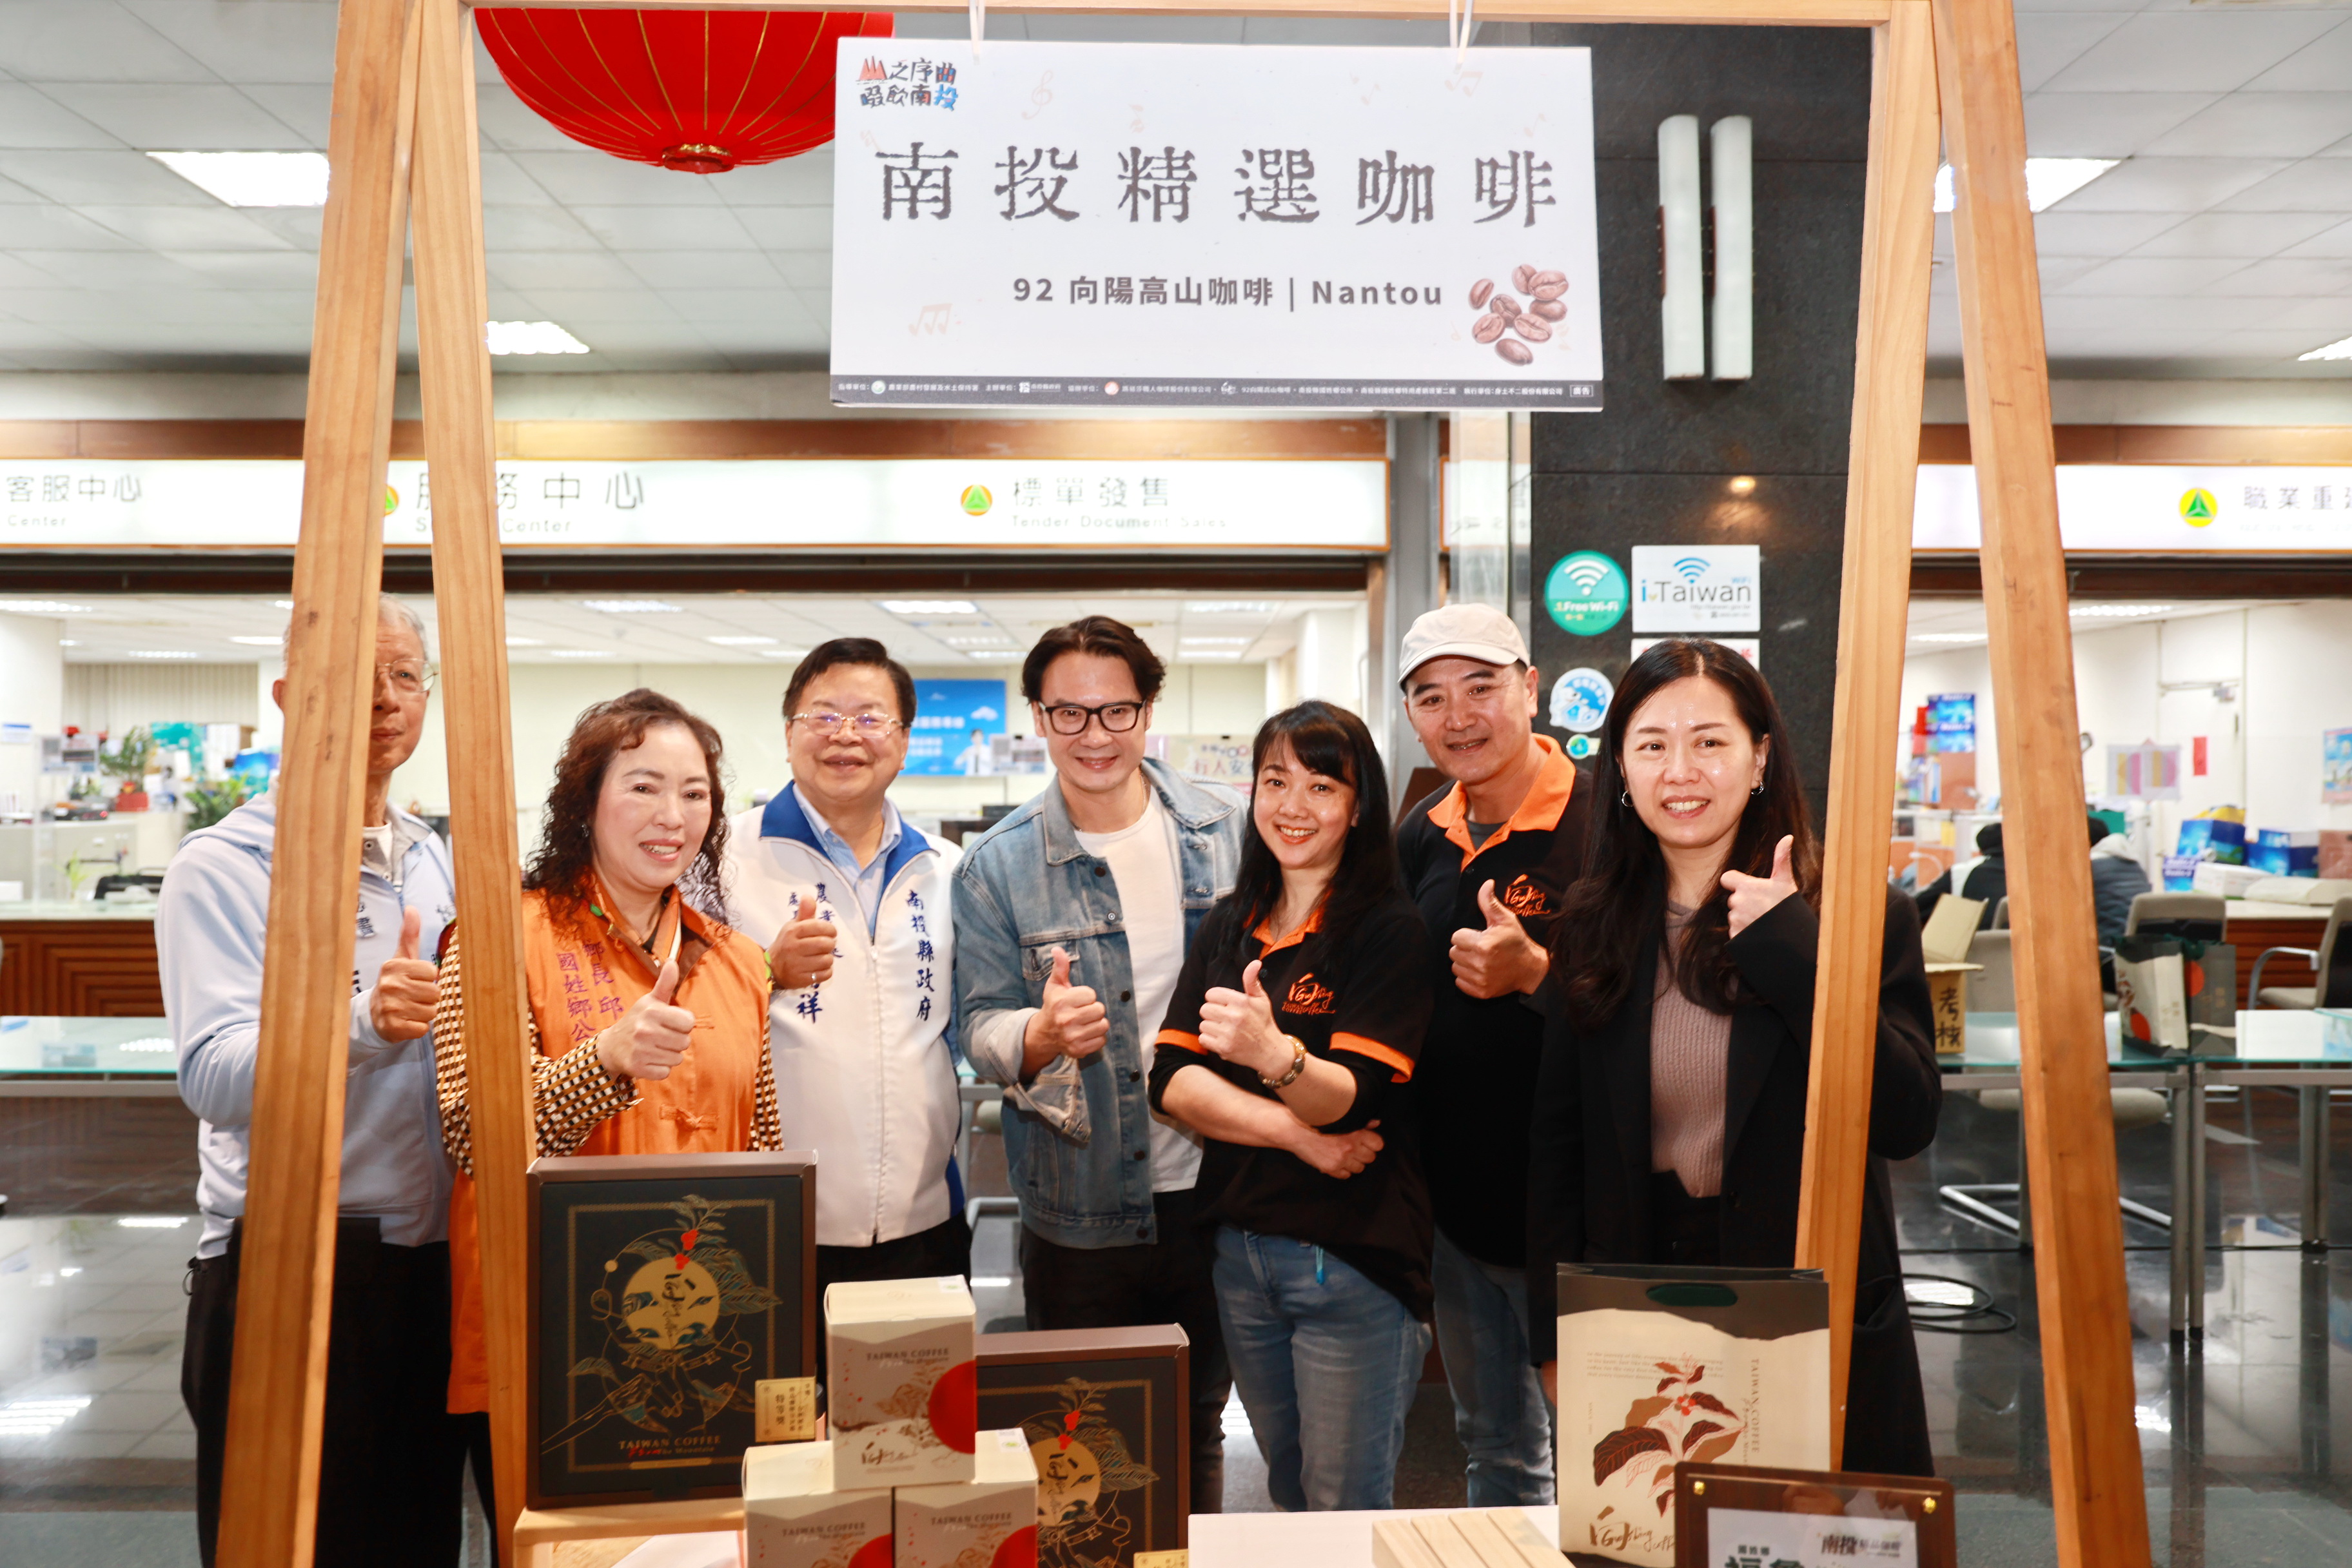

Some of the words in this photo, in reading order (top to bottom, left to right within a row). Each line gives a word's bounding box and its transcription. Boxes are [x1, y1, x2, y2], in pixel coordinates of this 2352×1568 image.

[875, 141, 1556, 228] 南投精選咖啡
[1013, 278, 1054, 302] 92
[1070, 275, 1273, 307] 向陽高山咖啡
[1312, 280, 1442, 306] Nantou
[6, 473, 142, 503] 客服中心
[1013, 476, 1168, 507] 標單發售
[7, 514, 66, 527] Center
[502, 518, 572, 533] Center
[1080, 515, 1169, 529] Document
[906, 889, 935, 1022] 南投縣政府
[867, 1351, 908, 1361] TAIWAN
[910, 1348, 949, 1358] COFFEE
[1751, 1358, 1760, 1404] TAIWAN
[618, 1438, 671, 1450] TAIWAN
[674, 1435, 721, 1447] COFFEE
[1751, 1409, 1760, 1453] COFFEE
